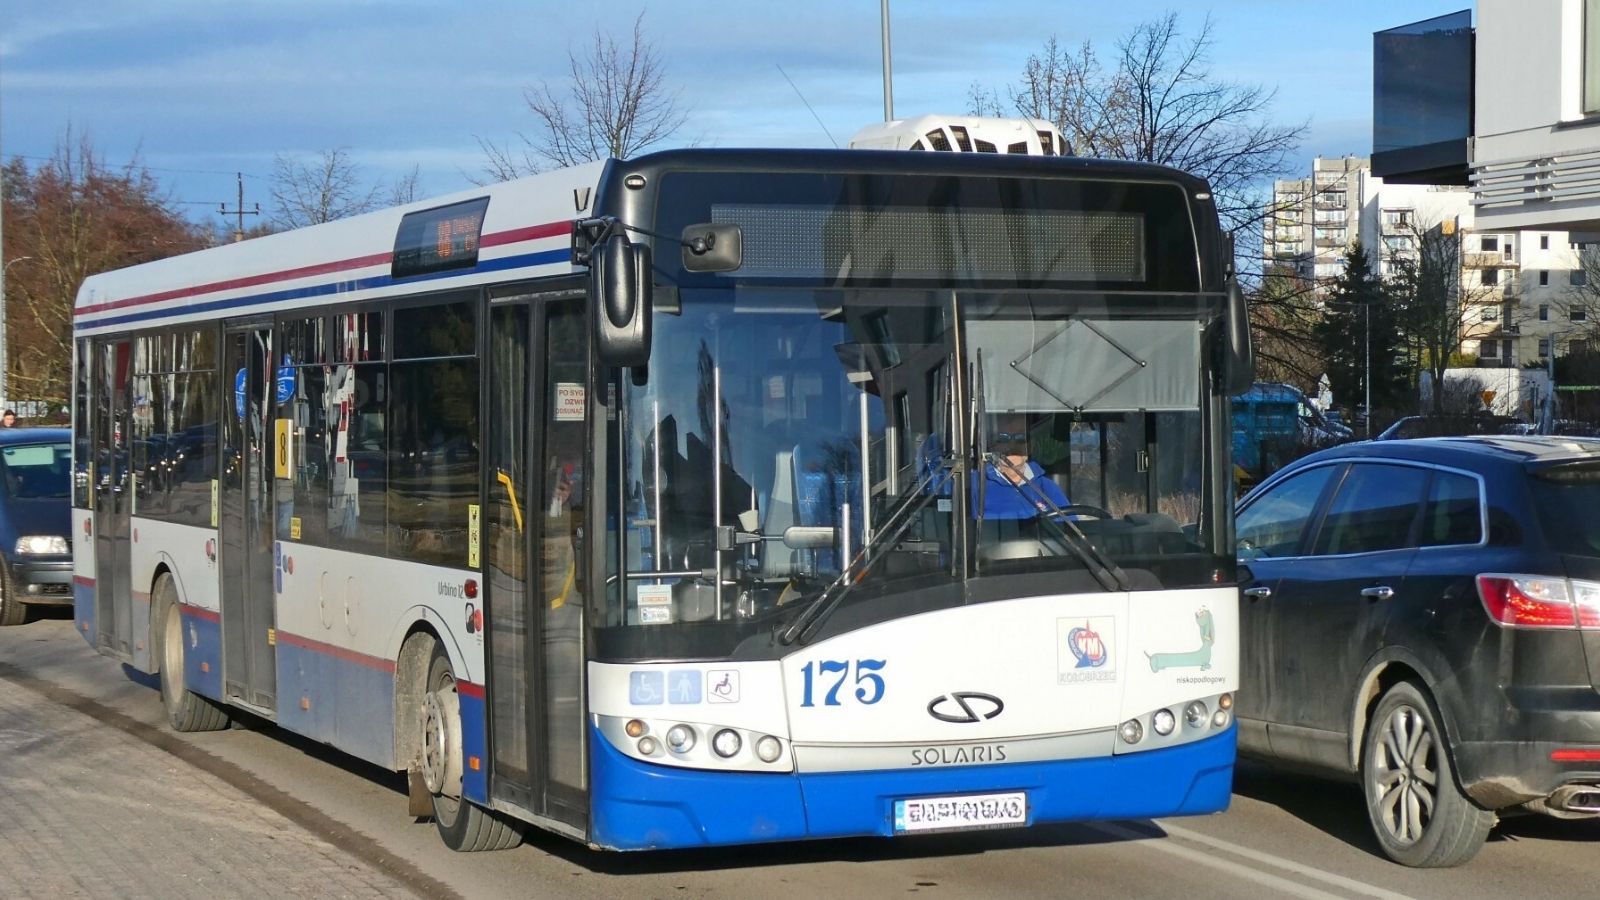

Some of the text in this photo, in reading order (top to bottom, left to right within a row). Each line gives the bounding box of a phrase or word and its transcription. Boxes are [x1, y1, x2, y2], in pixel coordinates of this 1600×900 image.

[280, 432, 286, 467] 8
[438, 581, 464, 599] Urbino 12
[800, 659, 887, 707] 175
[911, 745, 1006, 766] SOLARIS
